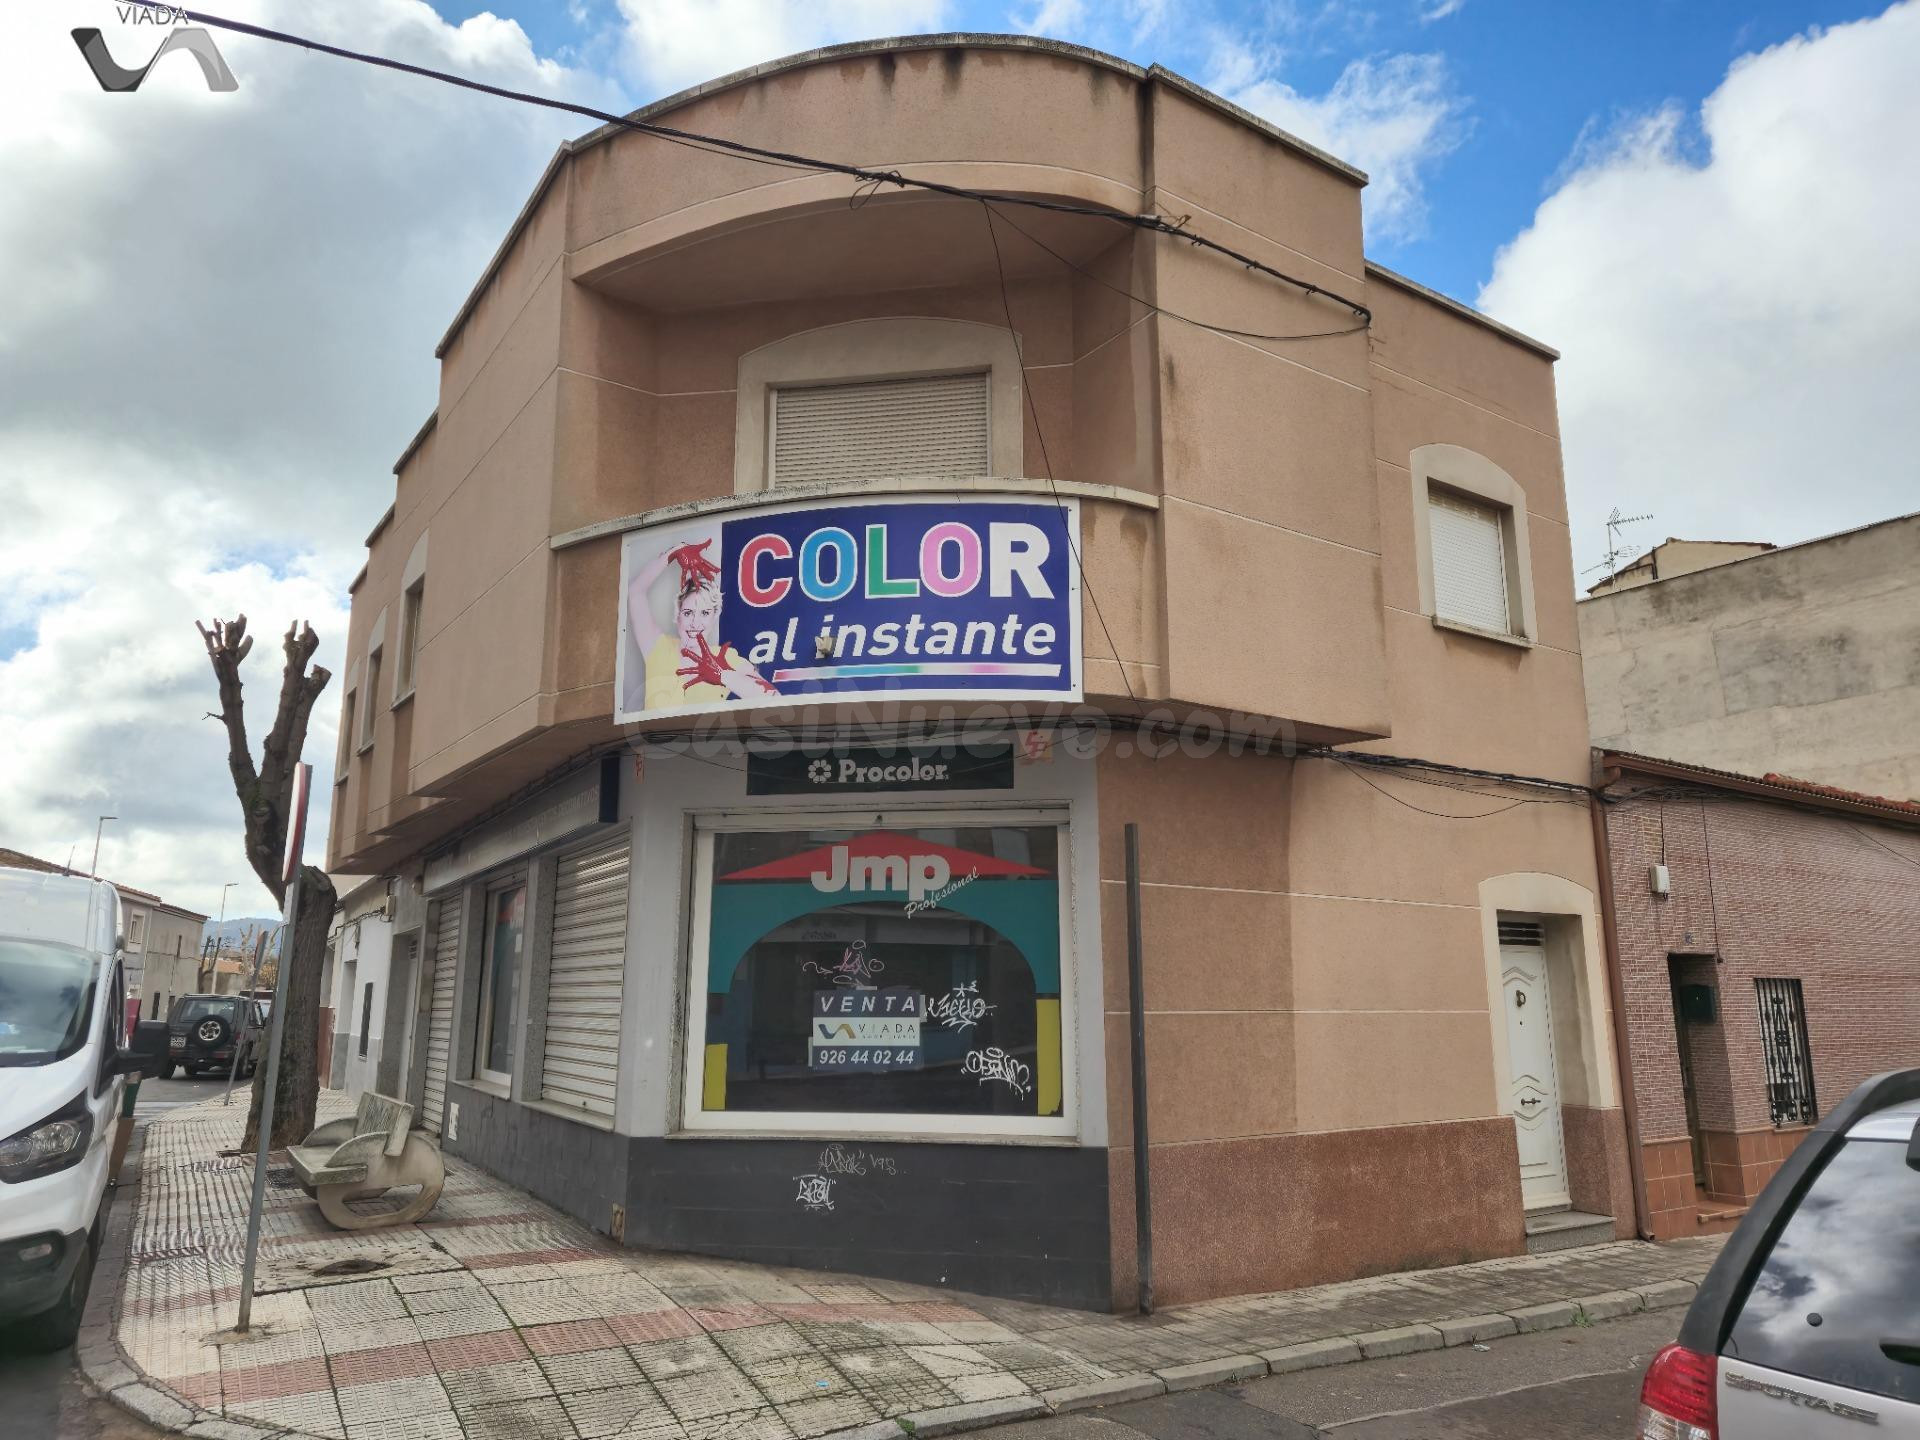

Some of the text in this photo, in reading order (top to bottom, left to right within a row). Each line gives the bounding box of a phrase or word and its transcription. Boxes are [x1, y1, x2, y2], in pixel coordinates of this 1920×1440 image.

[738, 521, 1054, 608] COLOR
[748, 614, 1056, 664] al instante
[838, 757, 947, 783] Procolor
[810, 845, 951, 901] Jmp
[904, 865, 979, 919] Profesional
[820, 996, 915, 1013] VENTA
[858, 1023, 916, 1034] VIADA
[819, 1050, 914, 1065] 926 44 02 44
